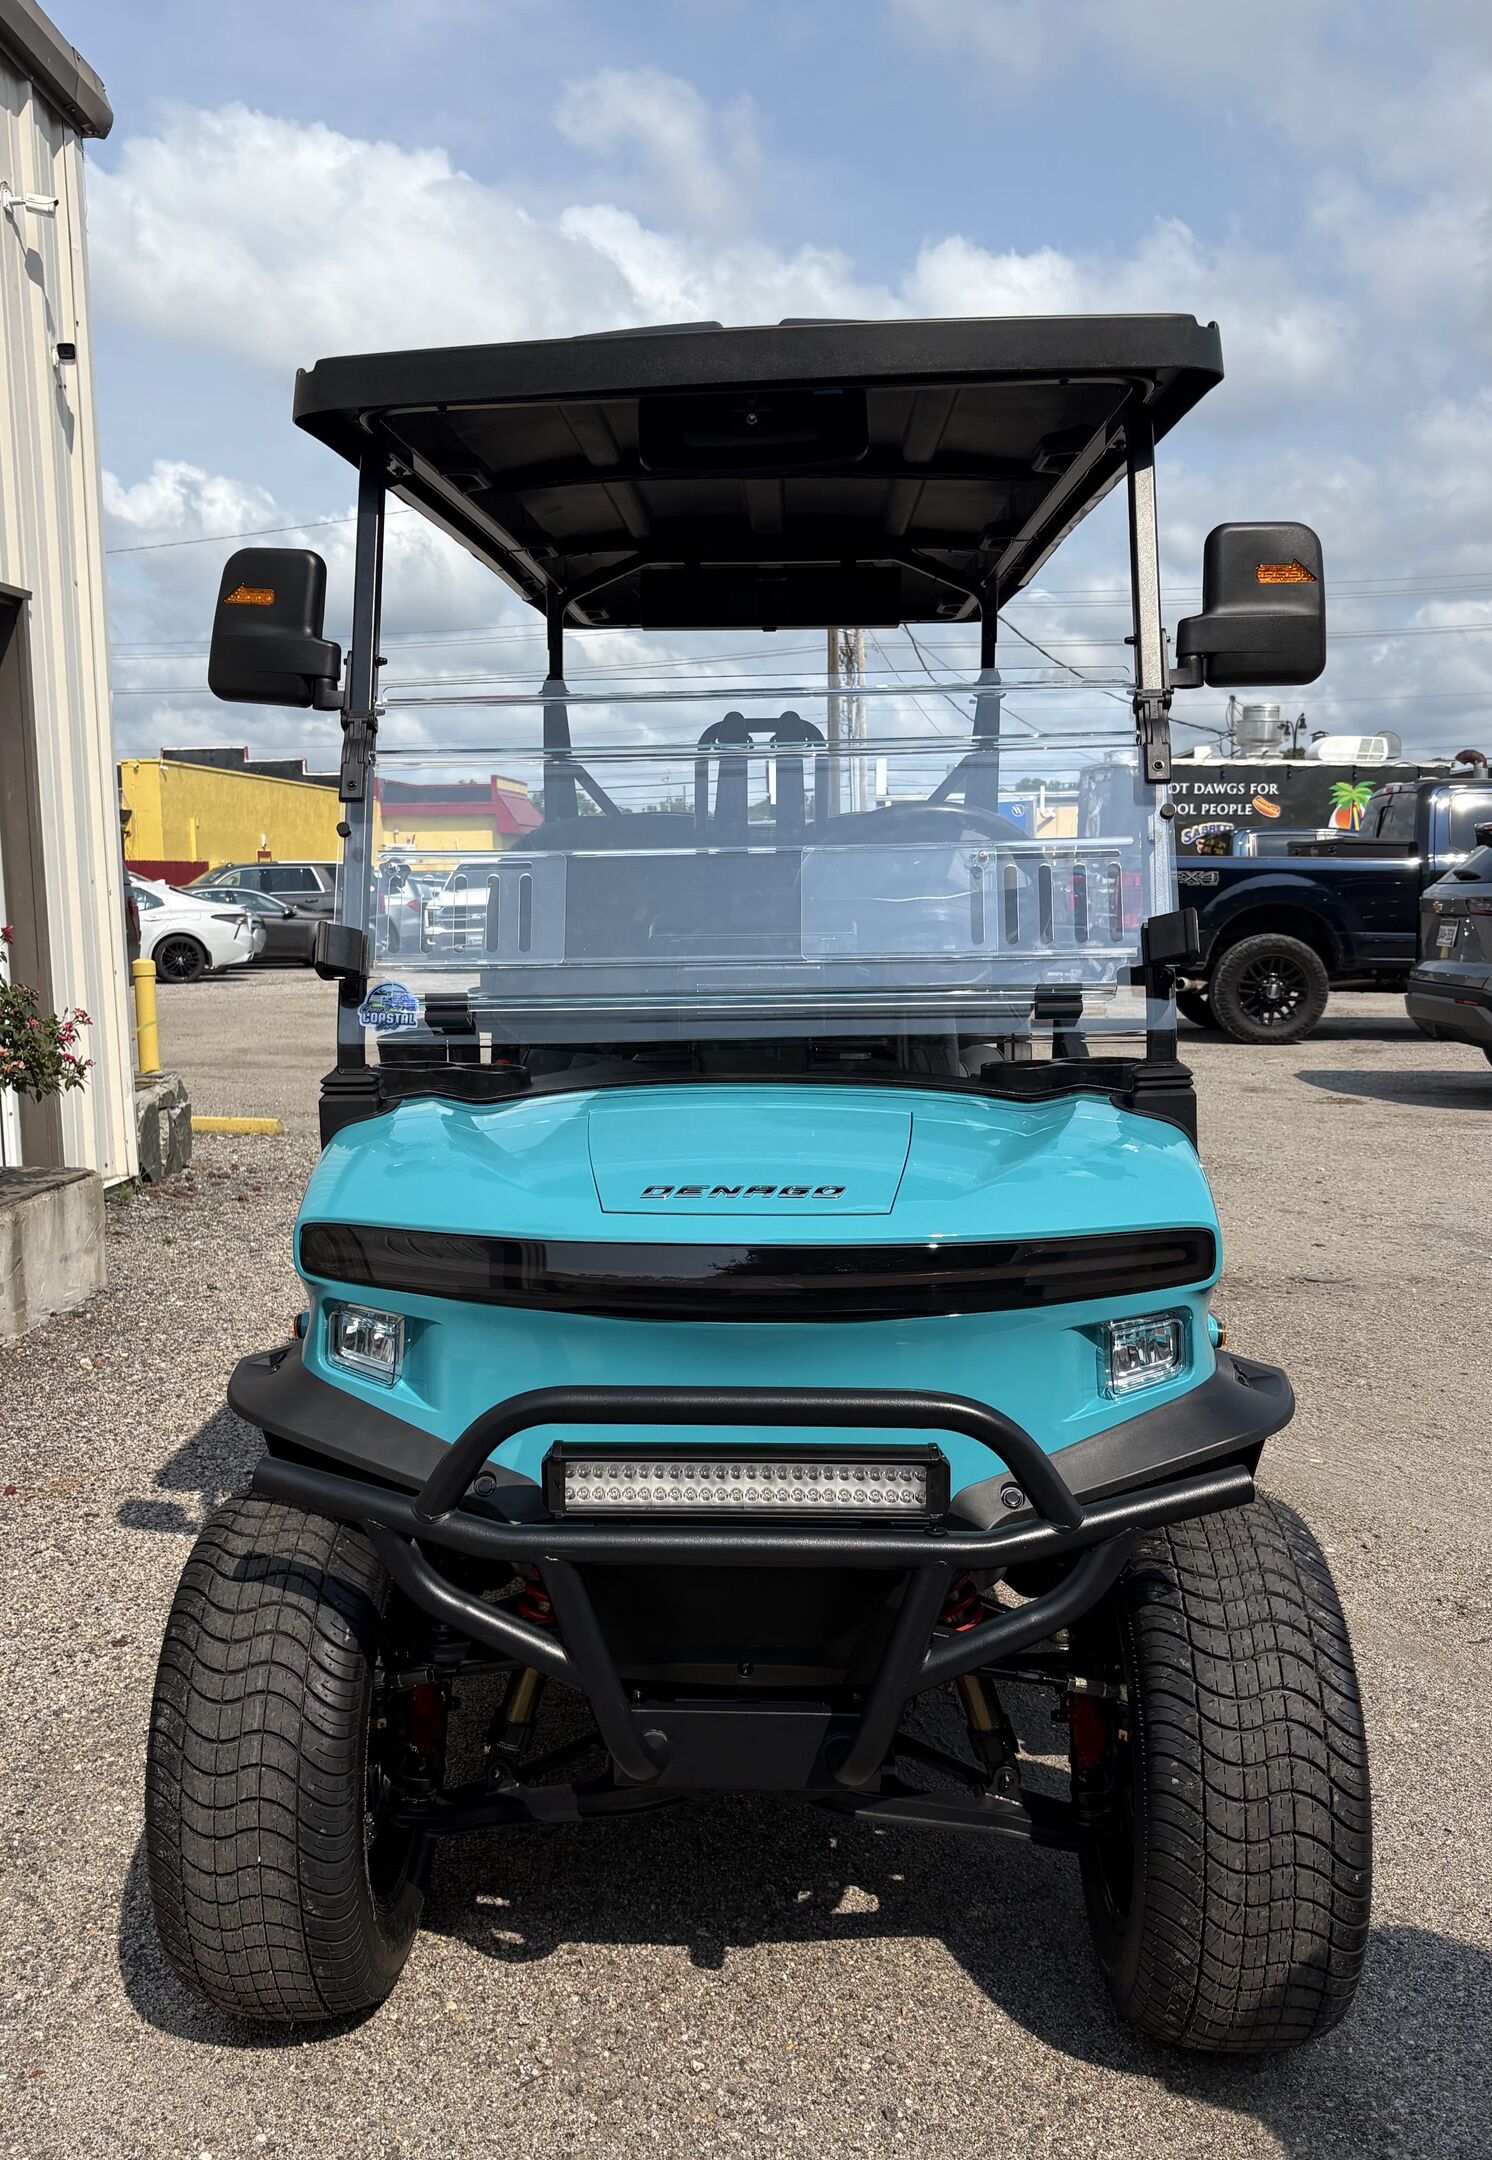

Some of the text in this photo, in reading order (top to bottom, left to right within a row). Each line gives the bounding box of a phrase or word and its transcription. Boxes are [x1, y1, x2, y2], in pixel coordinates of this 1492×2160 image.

[1168, 782, 1280, 795] OT DAWGS FOR
[1200, 803, 1253, 816] PEOPLE
[362, 1012, 416, 1025] COASTAL
[639, 1185, 847, 1200] DENAGO
